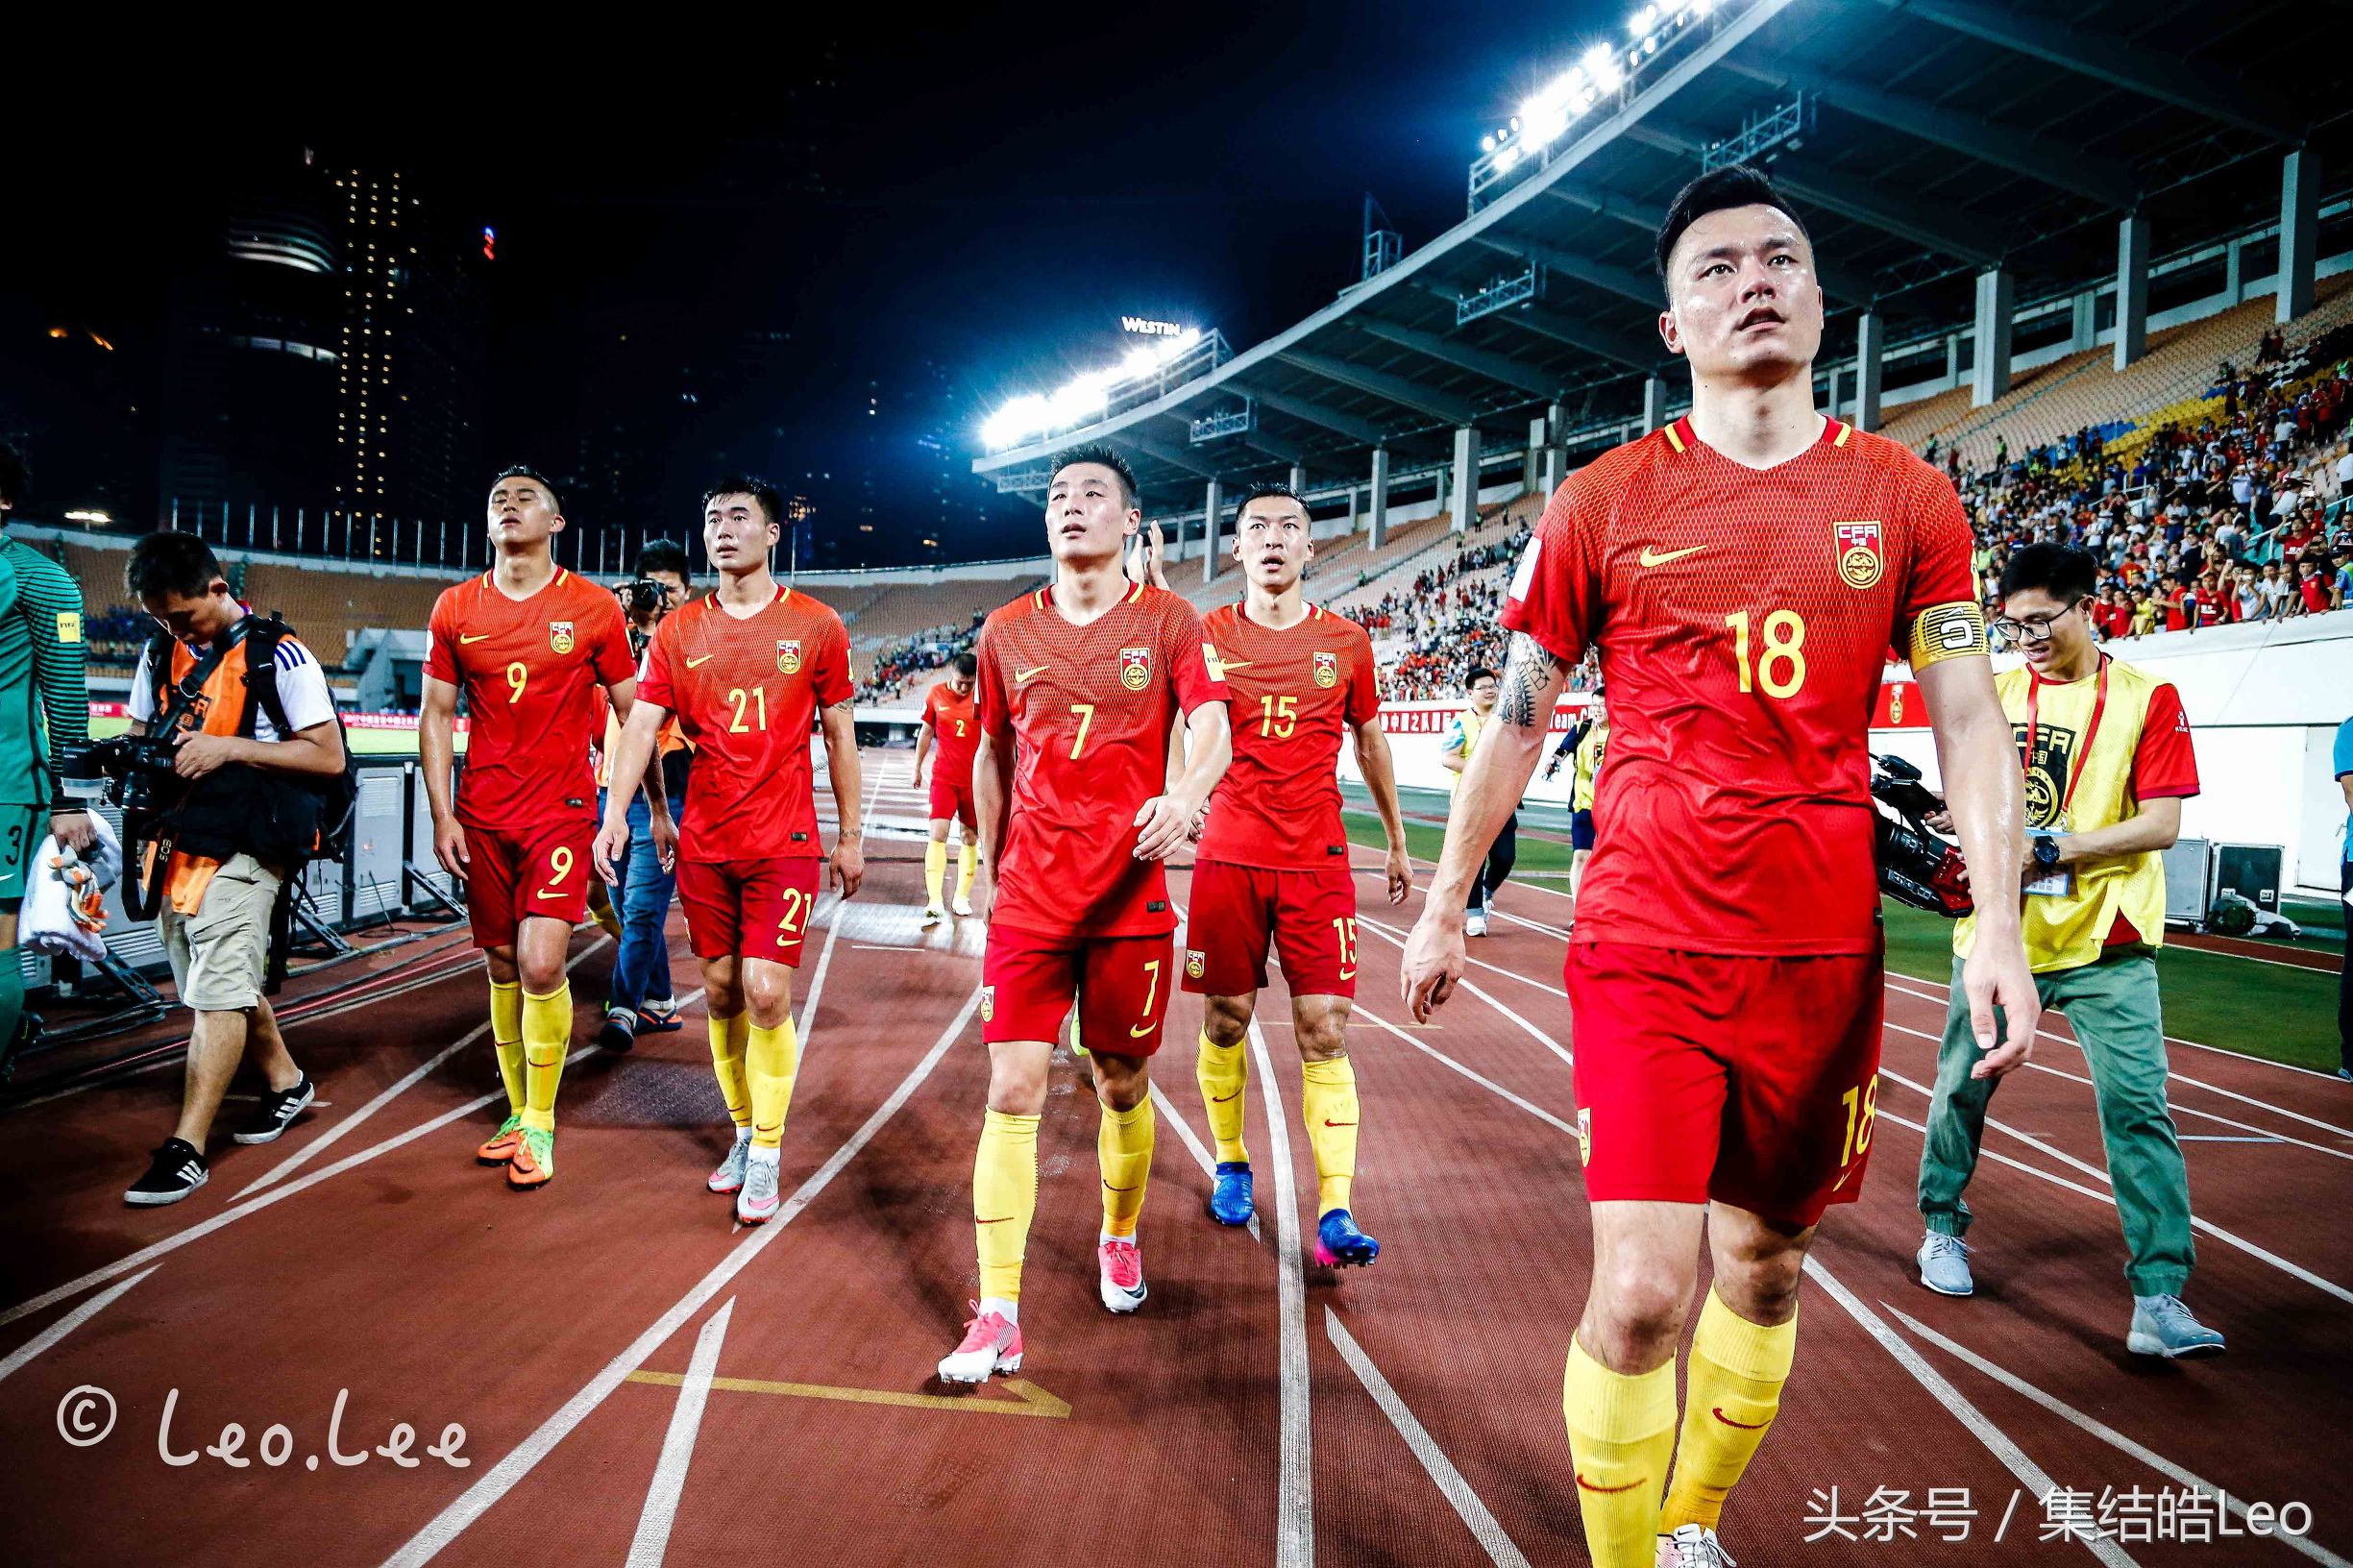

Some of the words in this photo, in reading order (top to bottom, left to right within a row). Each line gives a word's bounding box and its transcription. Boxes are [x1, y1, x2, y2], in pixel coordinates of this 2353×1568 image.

[1121, 315, 1181, 336] WESTIN
[1838, 525, 1878, 539] CFA
[1122, 649, 1148, 660] CFA
[1724, 607, 1806, 699] 18
[506, 661, 527, 704] 9
[727, 685, 767, 733] 21
[955, 719, 966, 737] 2
[1261, 695, 1298, 738] 15
[1550, 709, 1577, 730] Team
[1069, 702, 1094, 760] 7
[159, 838, 172, 863] EOS
[549, 845, 574, 886] 9
[777, 887, 812, 936] 21
[1333, 917, 1358, 965] 15
[1142, 959, 1160, 1017] 7
[1841, 1073, 1878, 1167] 18
